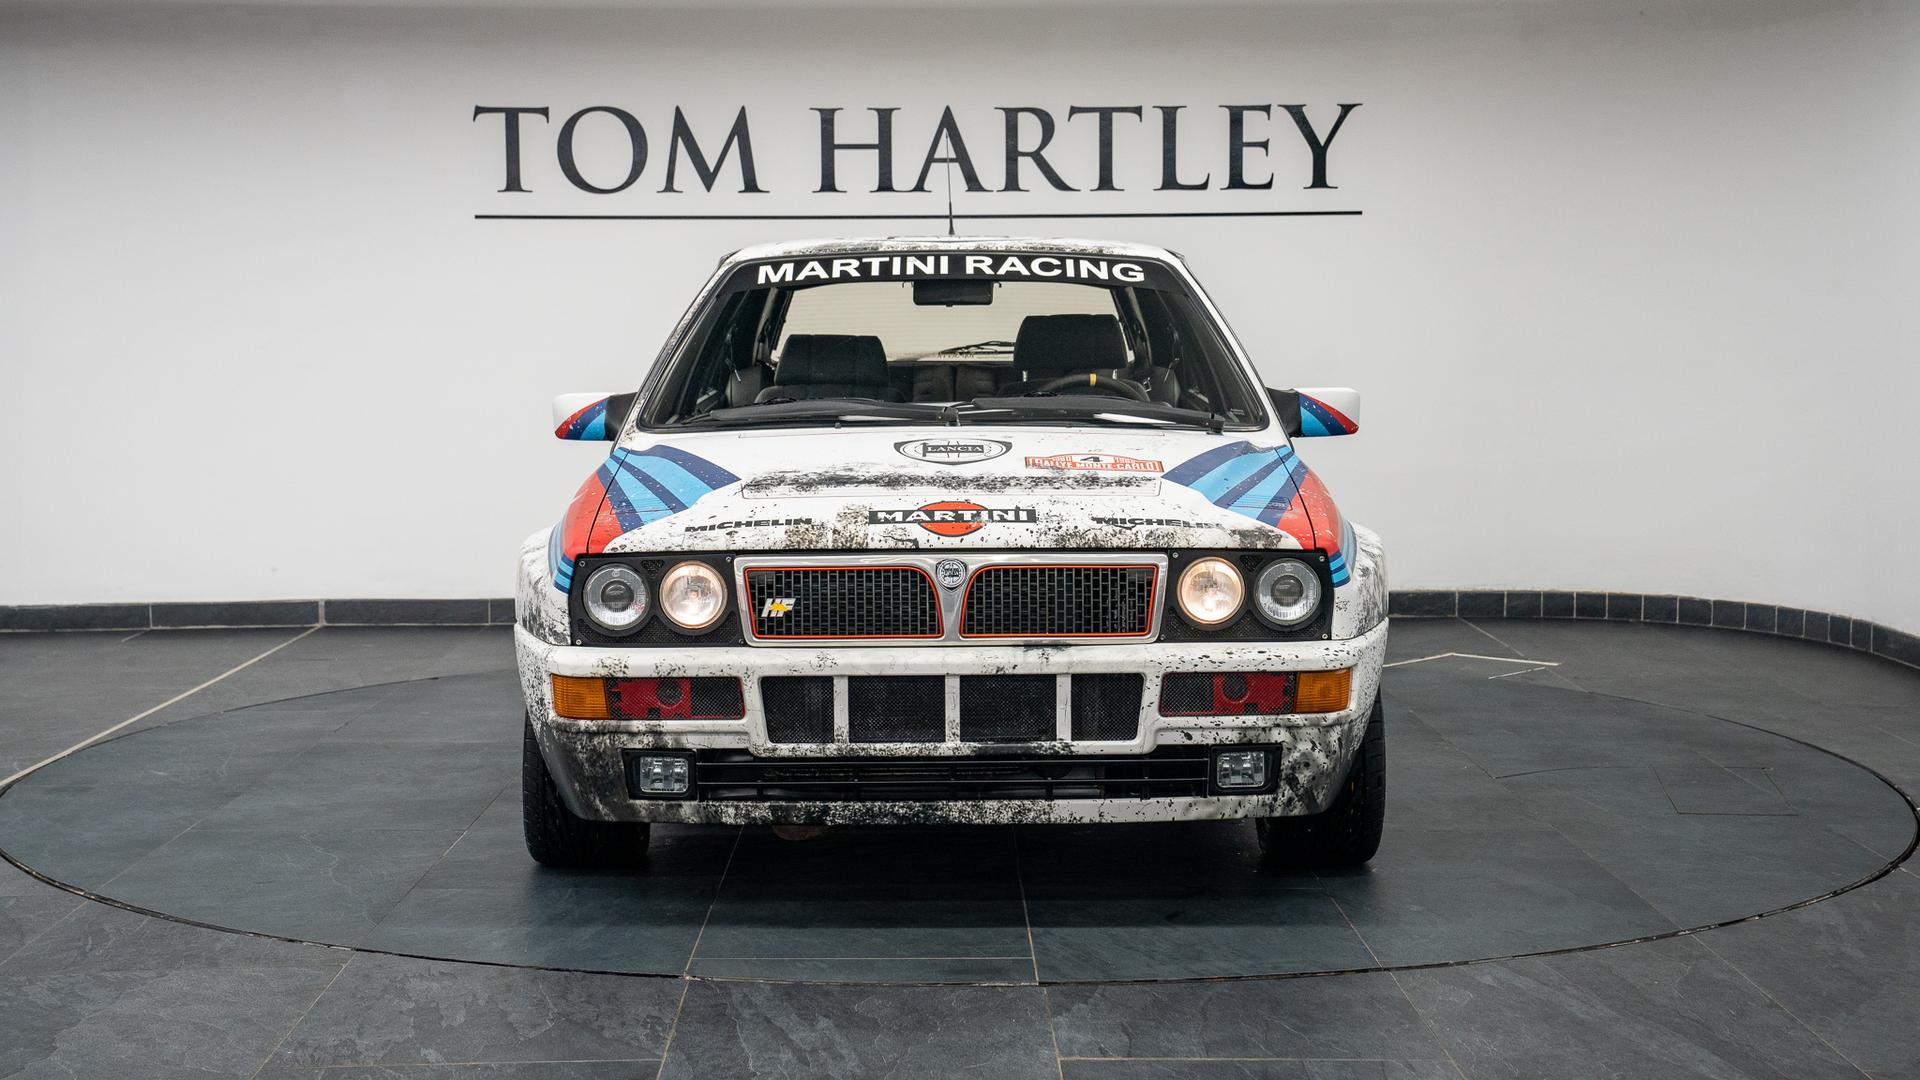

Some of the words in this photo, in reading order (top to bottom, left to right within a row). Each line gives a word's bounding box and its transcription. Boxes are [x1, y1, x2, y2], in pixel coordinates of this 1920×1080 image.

[473, 105, 770, 194] TOM
[809, 103, 1363, 193] HARTLEY
[757, 256, 949, 284] MARTINI
[965, 256, 1145, 282] RACING
[685, 518, 812, 532] MICHELIN
[877, 510, 1028, 522] MARTINI
[761, 598, 796, 617] HF
